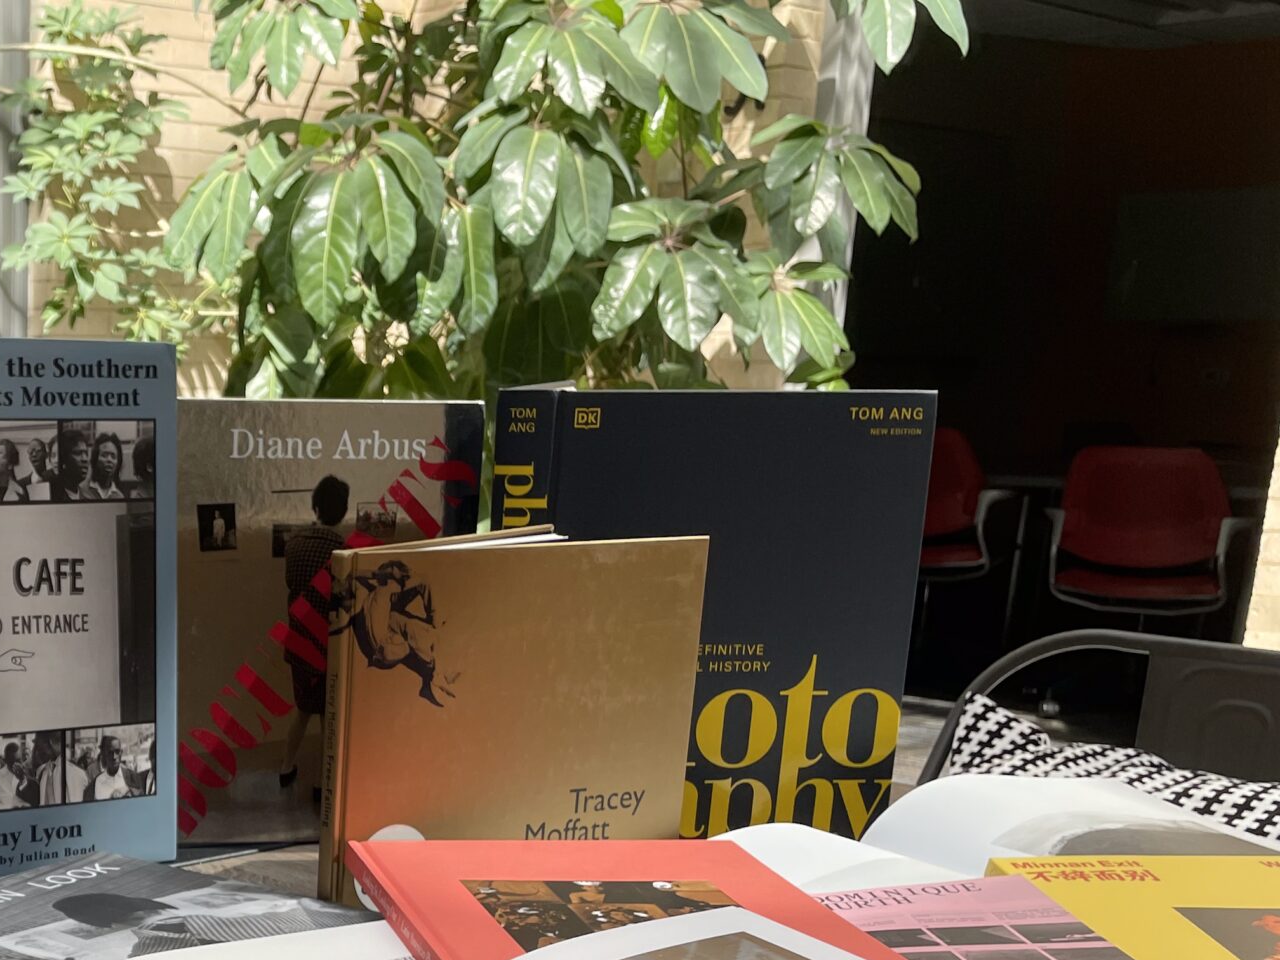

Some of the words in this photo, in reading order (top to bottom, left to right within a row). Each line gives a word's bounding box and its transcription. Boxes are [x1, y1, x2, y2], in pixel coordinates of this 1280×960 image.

[7, 357, 45, 378] the
[53, 357, 158, 379] Southern
[22, 386, 140, 407] Movement
[510, 407, 536, 420] TOM
[849, 407, 884, 420] TOM
[889, 407, 924, 420] ANG
[509, 422, 536, 433] ANG
[870, 427, 888, 435] NEW
[890, 427, 922, 435] EDITION
[230, 428, 322, 460] Diane
[332, 429, 426, 461] Arbus
[13, 557, 85, 597] CAFE
[11, 614, 89, 635] ENTRANCE
[696, 643, 764, 656] EFINITIVE
[709, 661, 771, 673] HISTORY
[570, 788, 645, 815] Tracey
[30, 823, 83, 845] Lyon
[525, 819, 610, 840] Moffatt
[0, 855, 15, 868] by
[19, 849, 59, 865] Julian
[64, 844, 96, 857] Bond
[1010, 860, 1095, 869] Minnan
[1096, 859, 1143, 868] Exit
[28, 862, 120, 890] LOOK
